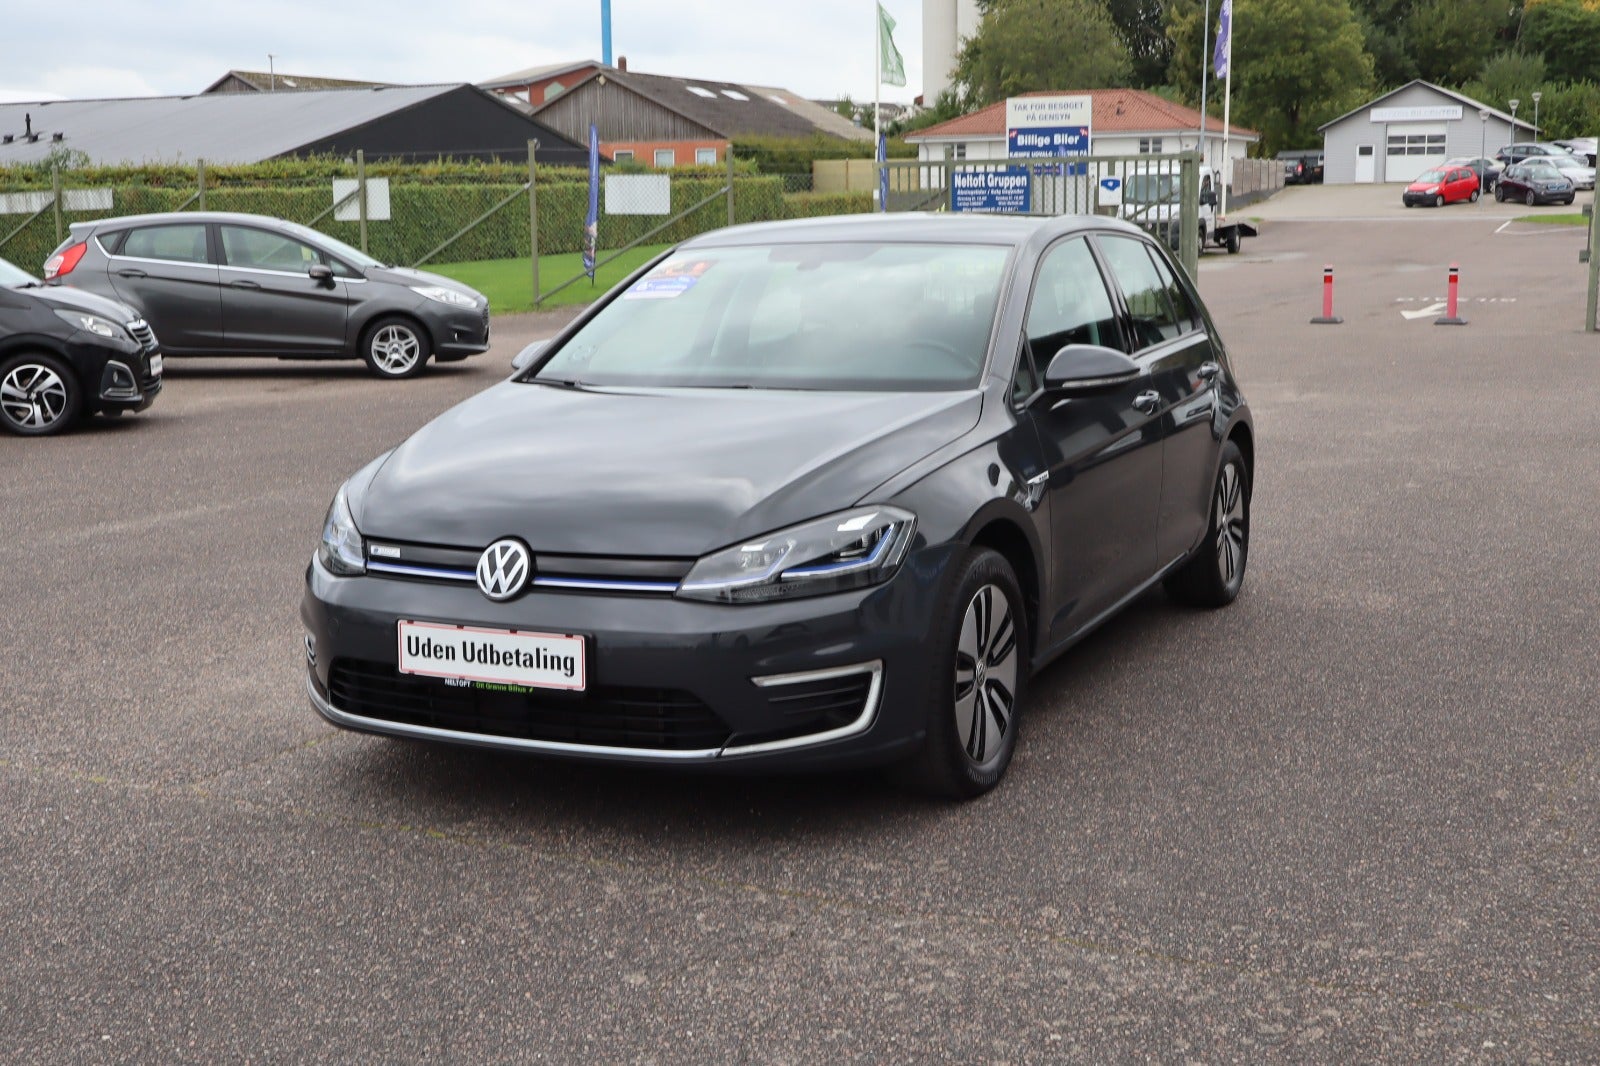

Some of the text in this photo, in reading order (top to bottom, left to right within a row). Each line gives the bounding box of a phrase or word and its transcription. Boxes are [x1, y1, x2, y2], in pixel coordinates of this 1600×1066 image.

[1017, 132, 1080, 148] Billige Biler
[954, 173, 1027, 190] Neltoft Gruppen
[407, 635, 575, 677] Uden Udbetaling
